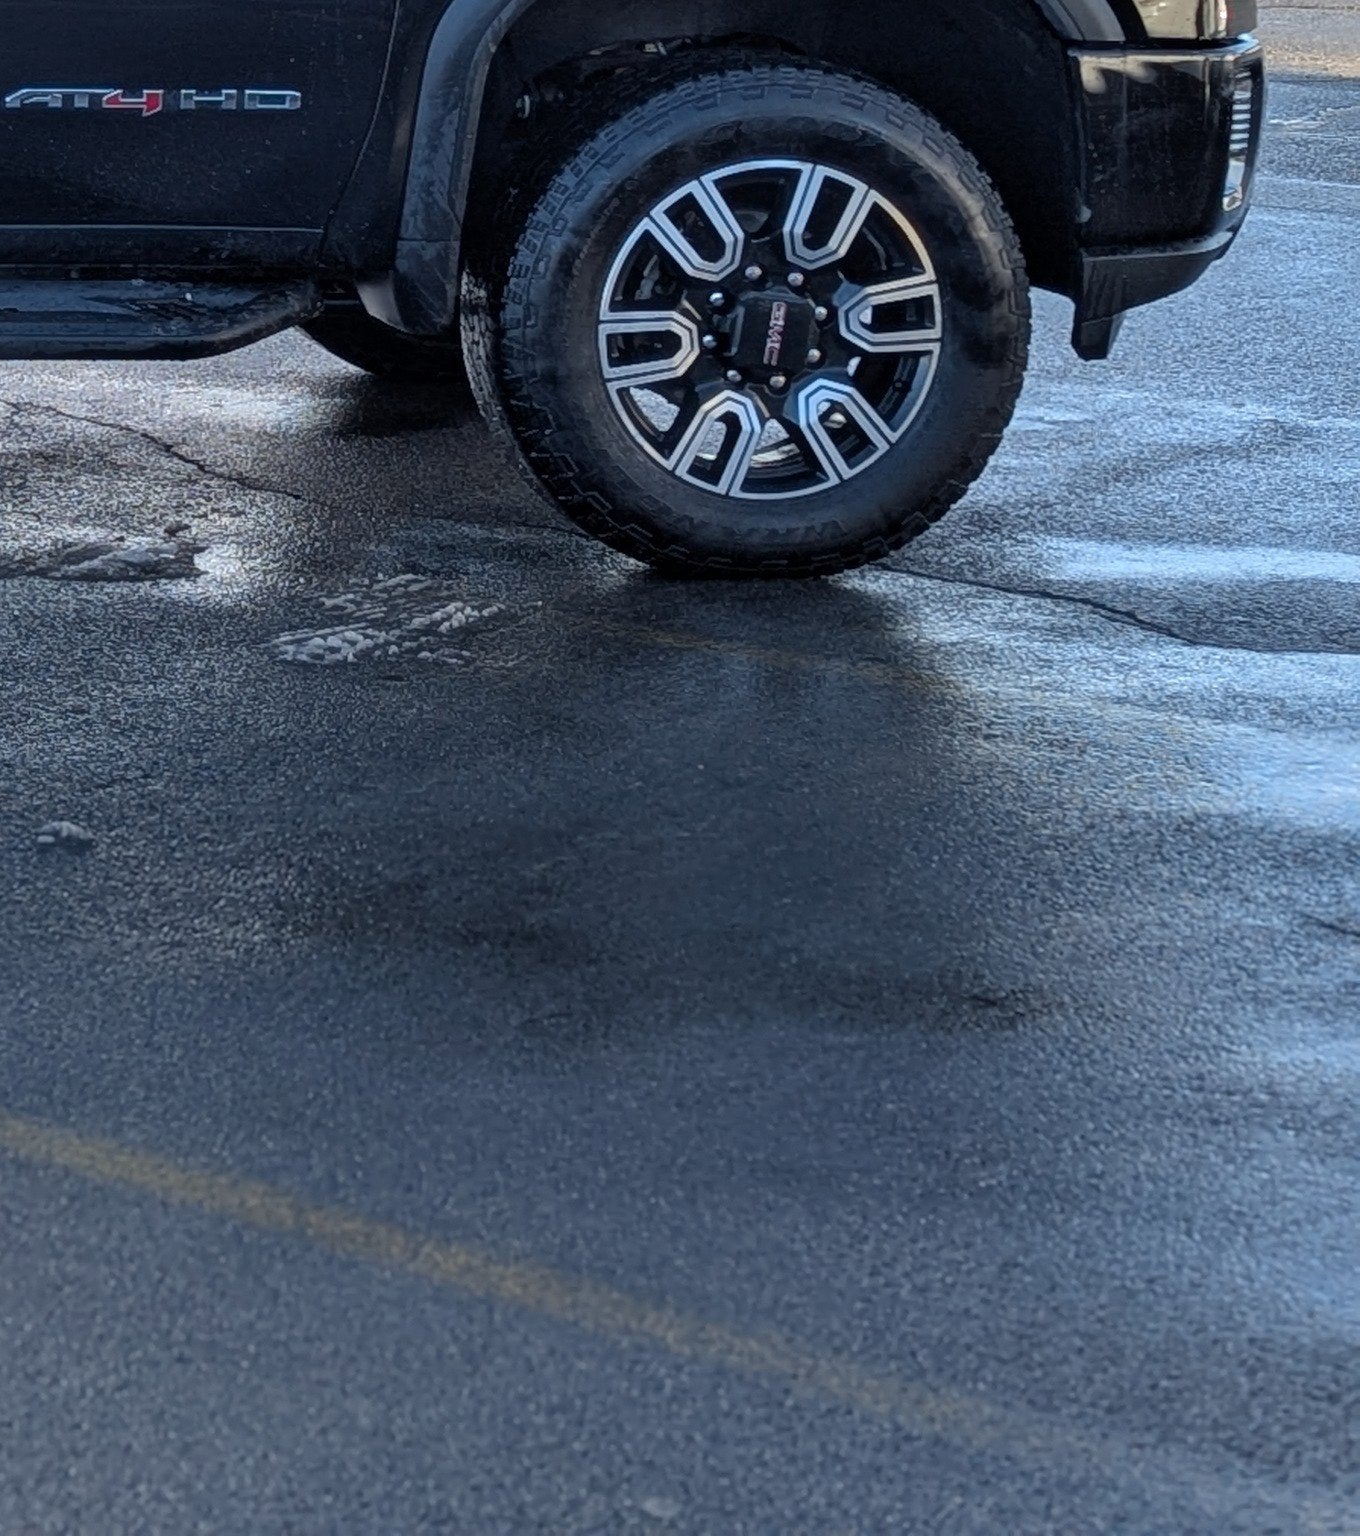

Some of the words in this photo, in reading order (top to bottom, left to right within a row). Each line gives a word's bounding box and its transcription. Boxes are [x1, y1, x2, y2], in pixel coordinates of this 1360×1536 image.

[5, 88, 164, 117] AT4
[180, 88, 301, 110] HD
[763, 301, 787, 366] GMC
